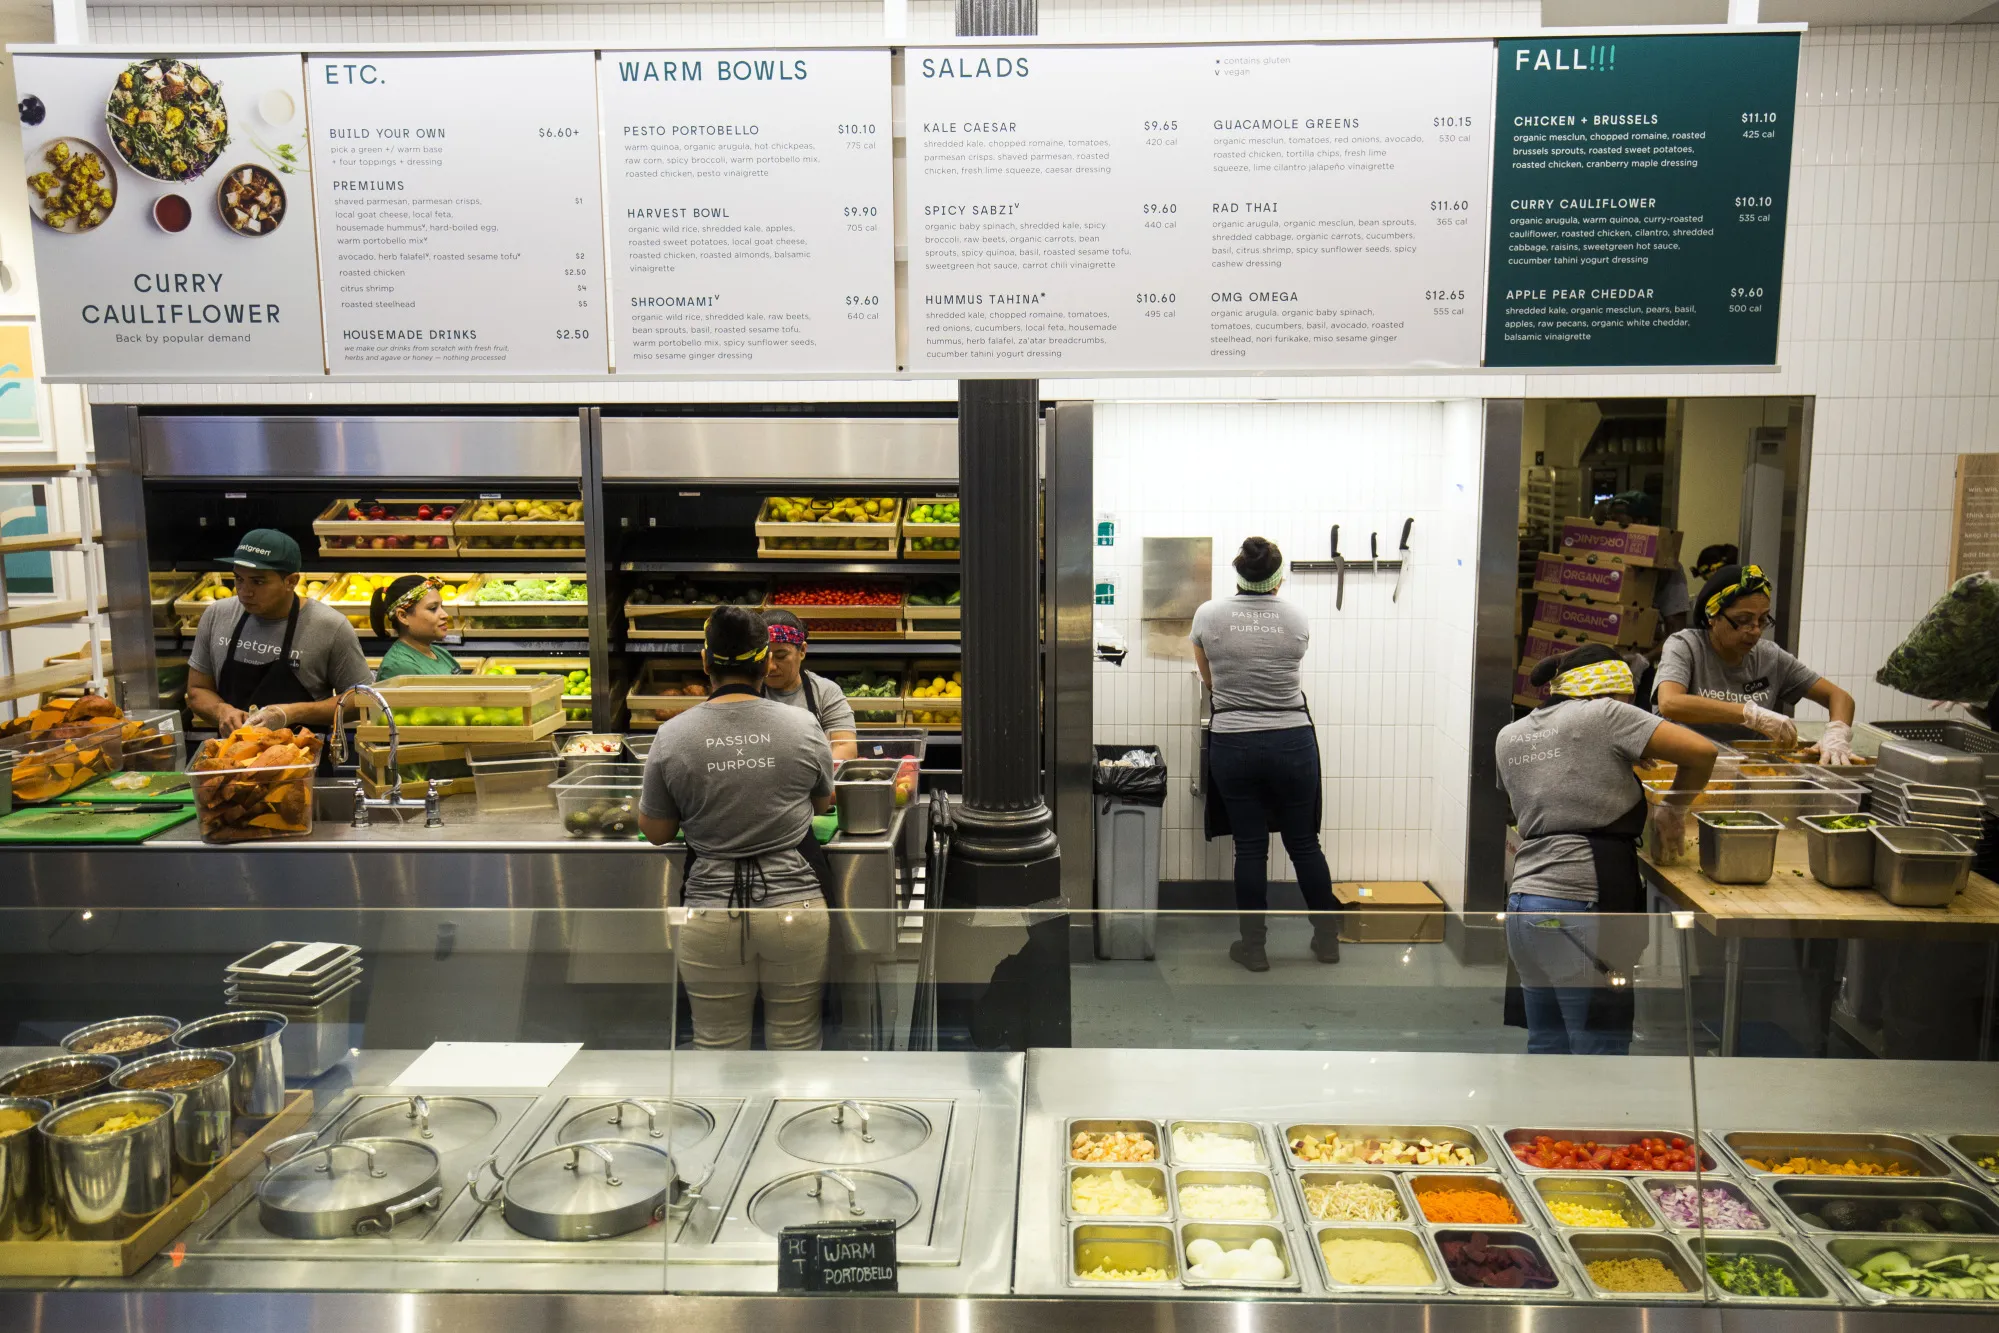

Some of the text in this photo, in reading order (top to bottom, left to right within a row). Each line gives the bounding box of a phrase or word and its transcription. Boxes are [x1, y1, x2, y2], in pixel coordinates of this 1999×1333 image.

[1516, 45, 1615, 72] FALL!!!
[618, 60, 807, 82] WARM BOWLS
[922, 57, 1029, 79] SALADS
[325, 64, 385, 85] ETC.
[1433, 116, 1472, 128] $10.15
[1514, 114, 1658, 127] CHICKEN + BRUSSELS
[1741, 112, 1777, 124] $11.10
[838, 124, 876, 135] $10.10
[923, 122, 1017, 133] KALE CAESAR
[1144, 120, 1178, 131] $9.65
[1213, 118, 1359, 130] GUACAMOLE GREENS
[329, 128, 445, 139] BUILD YOUR OWN
[538, 127, 580, 138] $6.60+
[623, 125, 759, 136] PESTO PORTOBELLO
[1742, 130, 1775, 139] 425 cal
[1513, 131, 1706, 144] organic mesclun, chopped romaine, roasted
[846, 141, 876, 150] 775 cal
[1512, 145, 1695, 156] brussels sprouts, roasted sweet potatoes,
[333, 180, 404, 191] PREMIUMS
[574, 197, 583, 205] $1
[1430, 200, 1469, 212] $11.60
[1510, 198, 1656, 210] CURRY CAULIFLOWER
[1735, 196, 1772, 208] $10.10
[844, 206, 877, 217] $9.90
[924, 205, 966, 216] SPICY
[1143, 203, 1177, 215] $9.60
[1212, 202, 1278, 213] RAD THAI
[627, 208, 730, 219] HARVEST BOWL
[1739, 214, 1771, 223] 535 cal
[1144, 220, 1177, 229] 440 cal
[1509, 216, 1543, 226] organic
[1544, 216, 1580, 226] arugula,
[1609, 216, 1642, 225] quinoa,
[1643, 214, 1704, 225] curry-roasted
[1509, 227, 1714, 239] cauliflower, roasted chicken, cilantro, shredded
[575, 252, 585, 260] $2
[629, 251, 662, 260] roasted
[700, 251, 732, 259] roasted
[774, 250, 811, 259] balsamic
[1507, 255, 1649, 266] cucumber tahini yogurt dressing
[564, 268, 587, 276] $2.50
[134, 273, 223, 293] CURRY
[577, 284, 587, 292] $4
[1211, 291, 1298, 303] OMG OMEGA
[1425, 290, 1465, 301] $12.65
[1506, 288, 1654, 300] APPLE PEAR CHEDDAR
[1730, 287, 1764, 298] $9.60
[578, 300, 588, 308] $5
[845, 295, 879, 306] $9.60
[925, 294, 983, 305] HUMMUS
[1136, 293, 1176, 304] $10.60
[341, 300, 416, 309] roasted steelhead
[1505, 304, 1697, 316] shredded kale, organic mesclun, pears, basil,
[1728, 304, 1762, 313] 500 cal
[81, 304, 280, 325] CAULIFLOWER
[847, 312, 879, 320] 640 cal
[1210, 310, 1243, 319] organic
[1281, 308, 1314, 318] organic
[1315, 308, 1338, 318] baby
[115, 333, 251, 345] Back by popular demand
[343, 329, 477, 340] HOUSEMADE DRINKS
[556, 329, 589, 340] $2.50
[1504, 332, 1592, 342] balsamic vinaigrette
[926, 350, 1062, 359] cucumber tahini yogurt dressing
[1572, 532, 1624, 548] ORGANIC
[1563, 569, 1611, 585] ORGANIC
[1231, 611, 1280, 619] PASSION
[1562, 613, 1609, 628] ORGANIC
[1229, 625, 1285, 634] PURPOSE
[1509, 726, 1559, 744] PASSION
[705, 733, 771, 749] PASSION
[1508, 747, 1561, 767] PURPOSE
[706, 757, 776, 773] PURPOSE
[823, 1241, 876, 1262] WARM
[822, 1265, 893, 1285] PORTOBELLO
